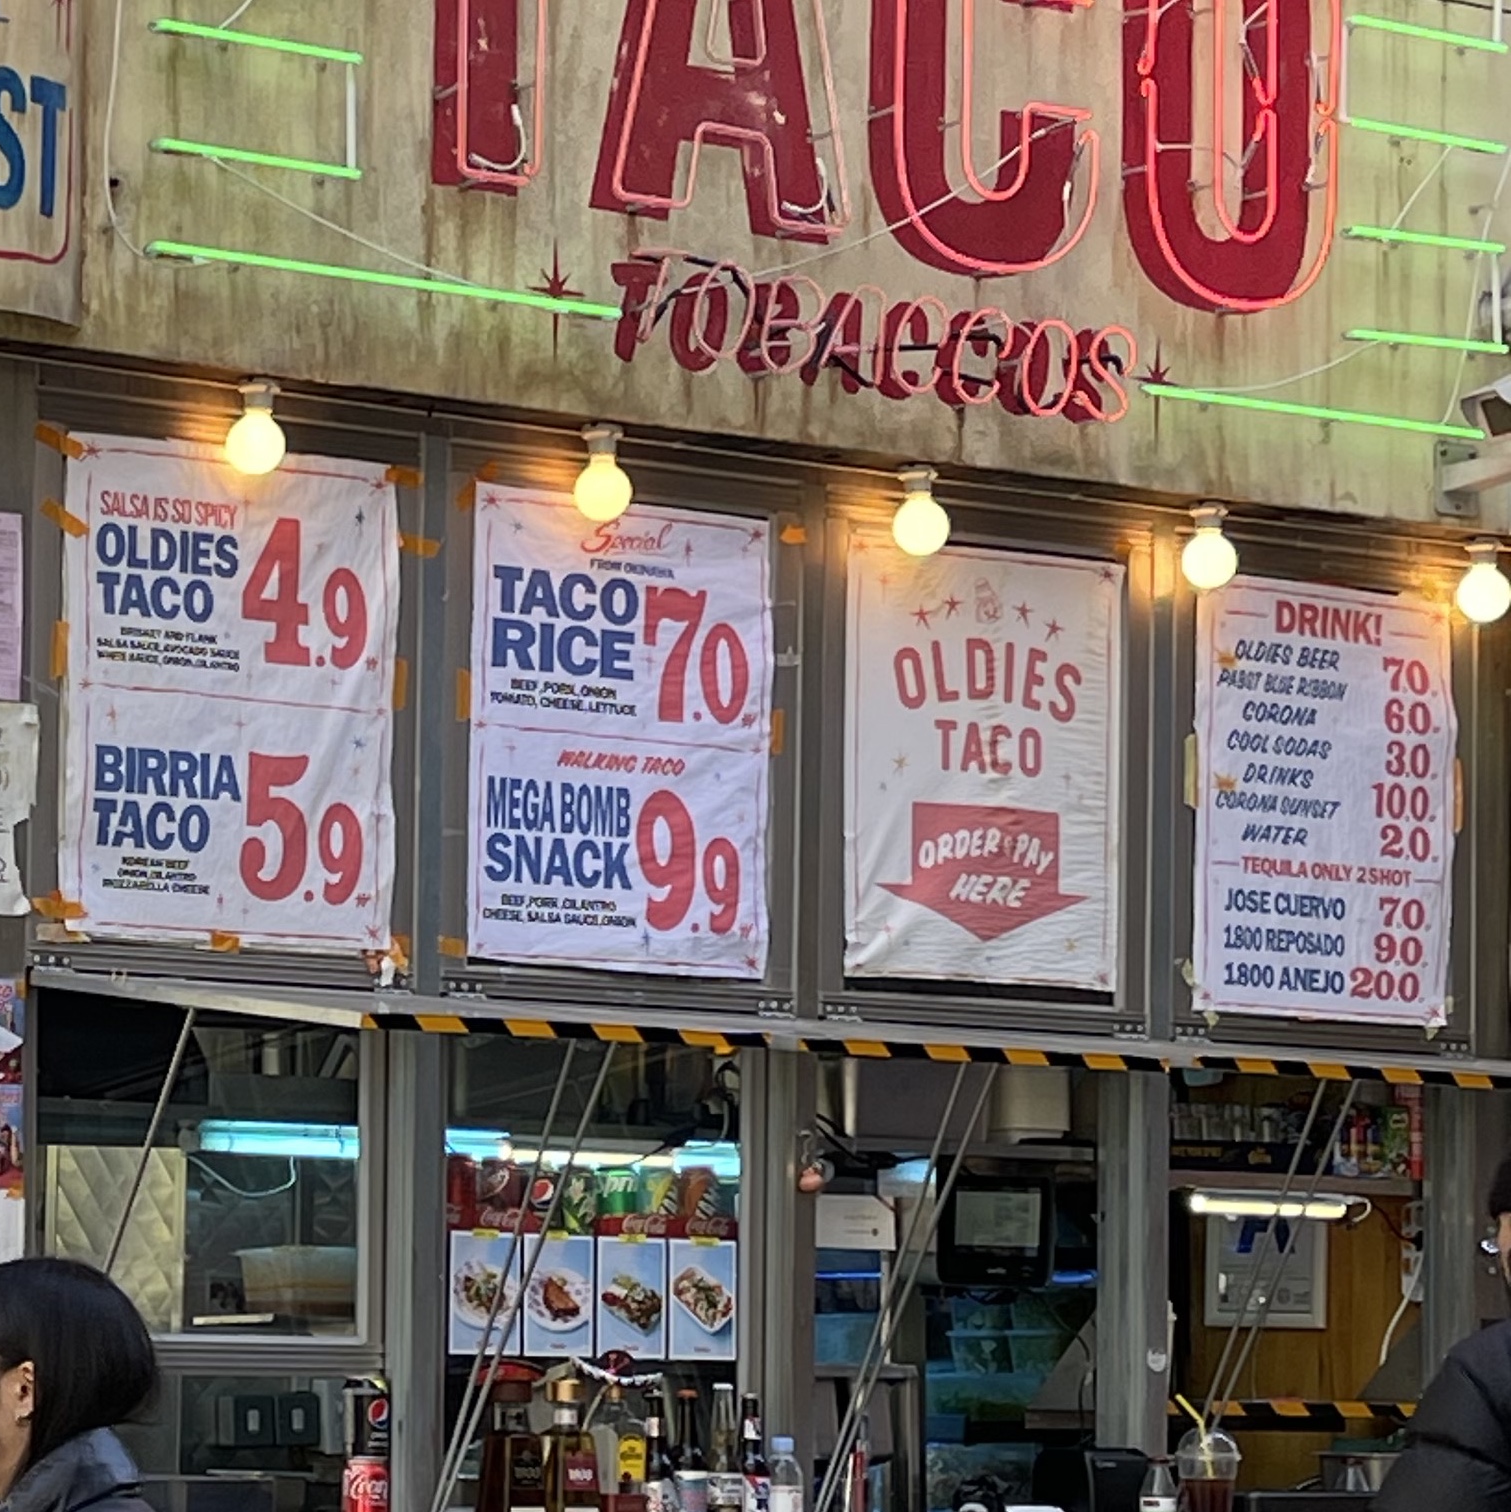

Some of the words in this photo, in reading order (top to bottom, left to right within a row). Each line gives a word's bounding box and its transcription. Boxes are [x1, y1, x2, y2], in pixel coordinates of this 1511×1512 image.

[611, 250, 1136, 424] TOBACCOS
[100, 490, 150, 518] SALSA
[172, 499, 192, 525] SO
[194, 502, 238, 529] SPICY
[97, 522, 238, 579] OLDIES
[581, 520, 673, 555] Special
[97, 571, 214, 623] TACO
[493, 564, 638, 626] TACO
[1275, 600, 1383, 647] DRINK!
[491, 617, 635, 680] RICE
[1235, 640, 1293, 665] OLDIES
[1297, 647, 1340, 671] BEER
[894, 637, 1082, 723] OLDIES
[1217, 668, 1262, 690] PABST
[1242, 701, 1317, 726] CORONA
[557, 749, 637, 774] WALKING
[641, 756, 685, 776] TACO
[934, 719, 1042, 778] TACO
[1227, 729, 1271, 752] COOL
[1272, 735, 1332, 760] SODAS
[94, 744, 241, 803] BIRRIA
[1243, 762, 1314, 789] DRINKS
[487, 776, 556, 834] MEGA
[561, 783, 630, 838] BOMB
[1215, 789, 1278, 812] CORONA
[1279, 797, 1341, 820] SUNSET
[94, 798, 210, 853] TACO
[1241, 823, 1308, 847] WATER
[485, 832, 632, 890] SNACK
[919, 827, 998, 868] ORDER
[1014, 833, 1055, 875] PAY
[1241, 856, 1308, 879] TEQUILA
[1311, 861, 1352, 882] ONLY
[950, 873, 1031, 908] HERE
[1224, 888, 1271, 913] JOSE
[1274, 895, 1346, 921] CUERVO
[1223, 924, 1263, 952] 1800
[1265, 927, 1345, 957] REPOSADO
[1223, 962, 1274, 988] 1800
